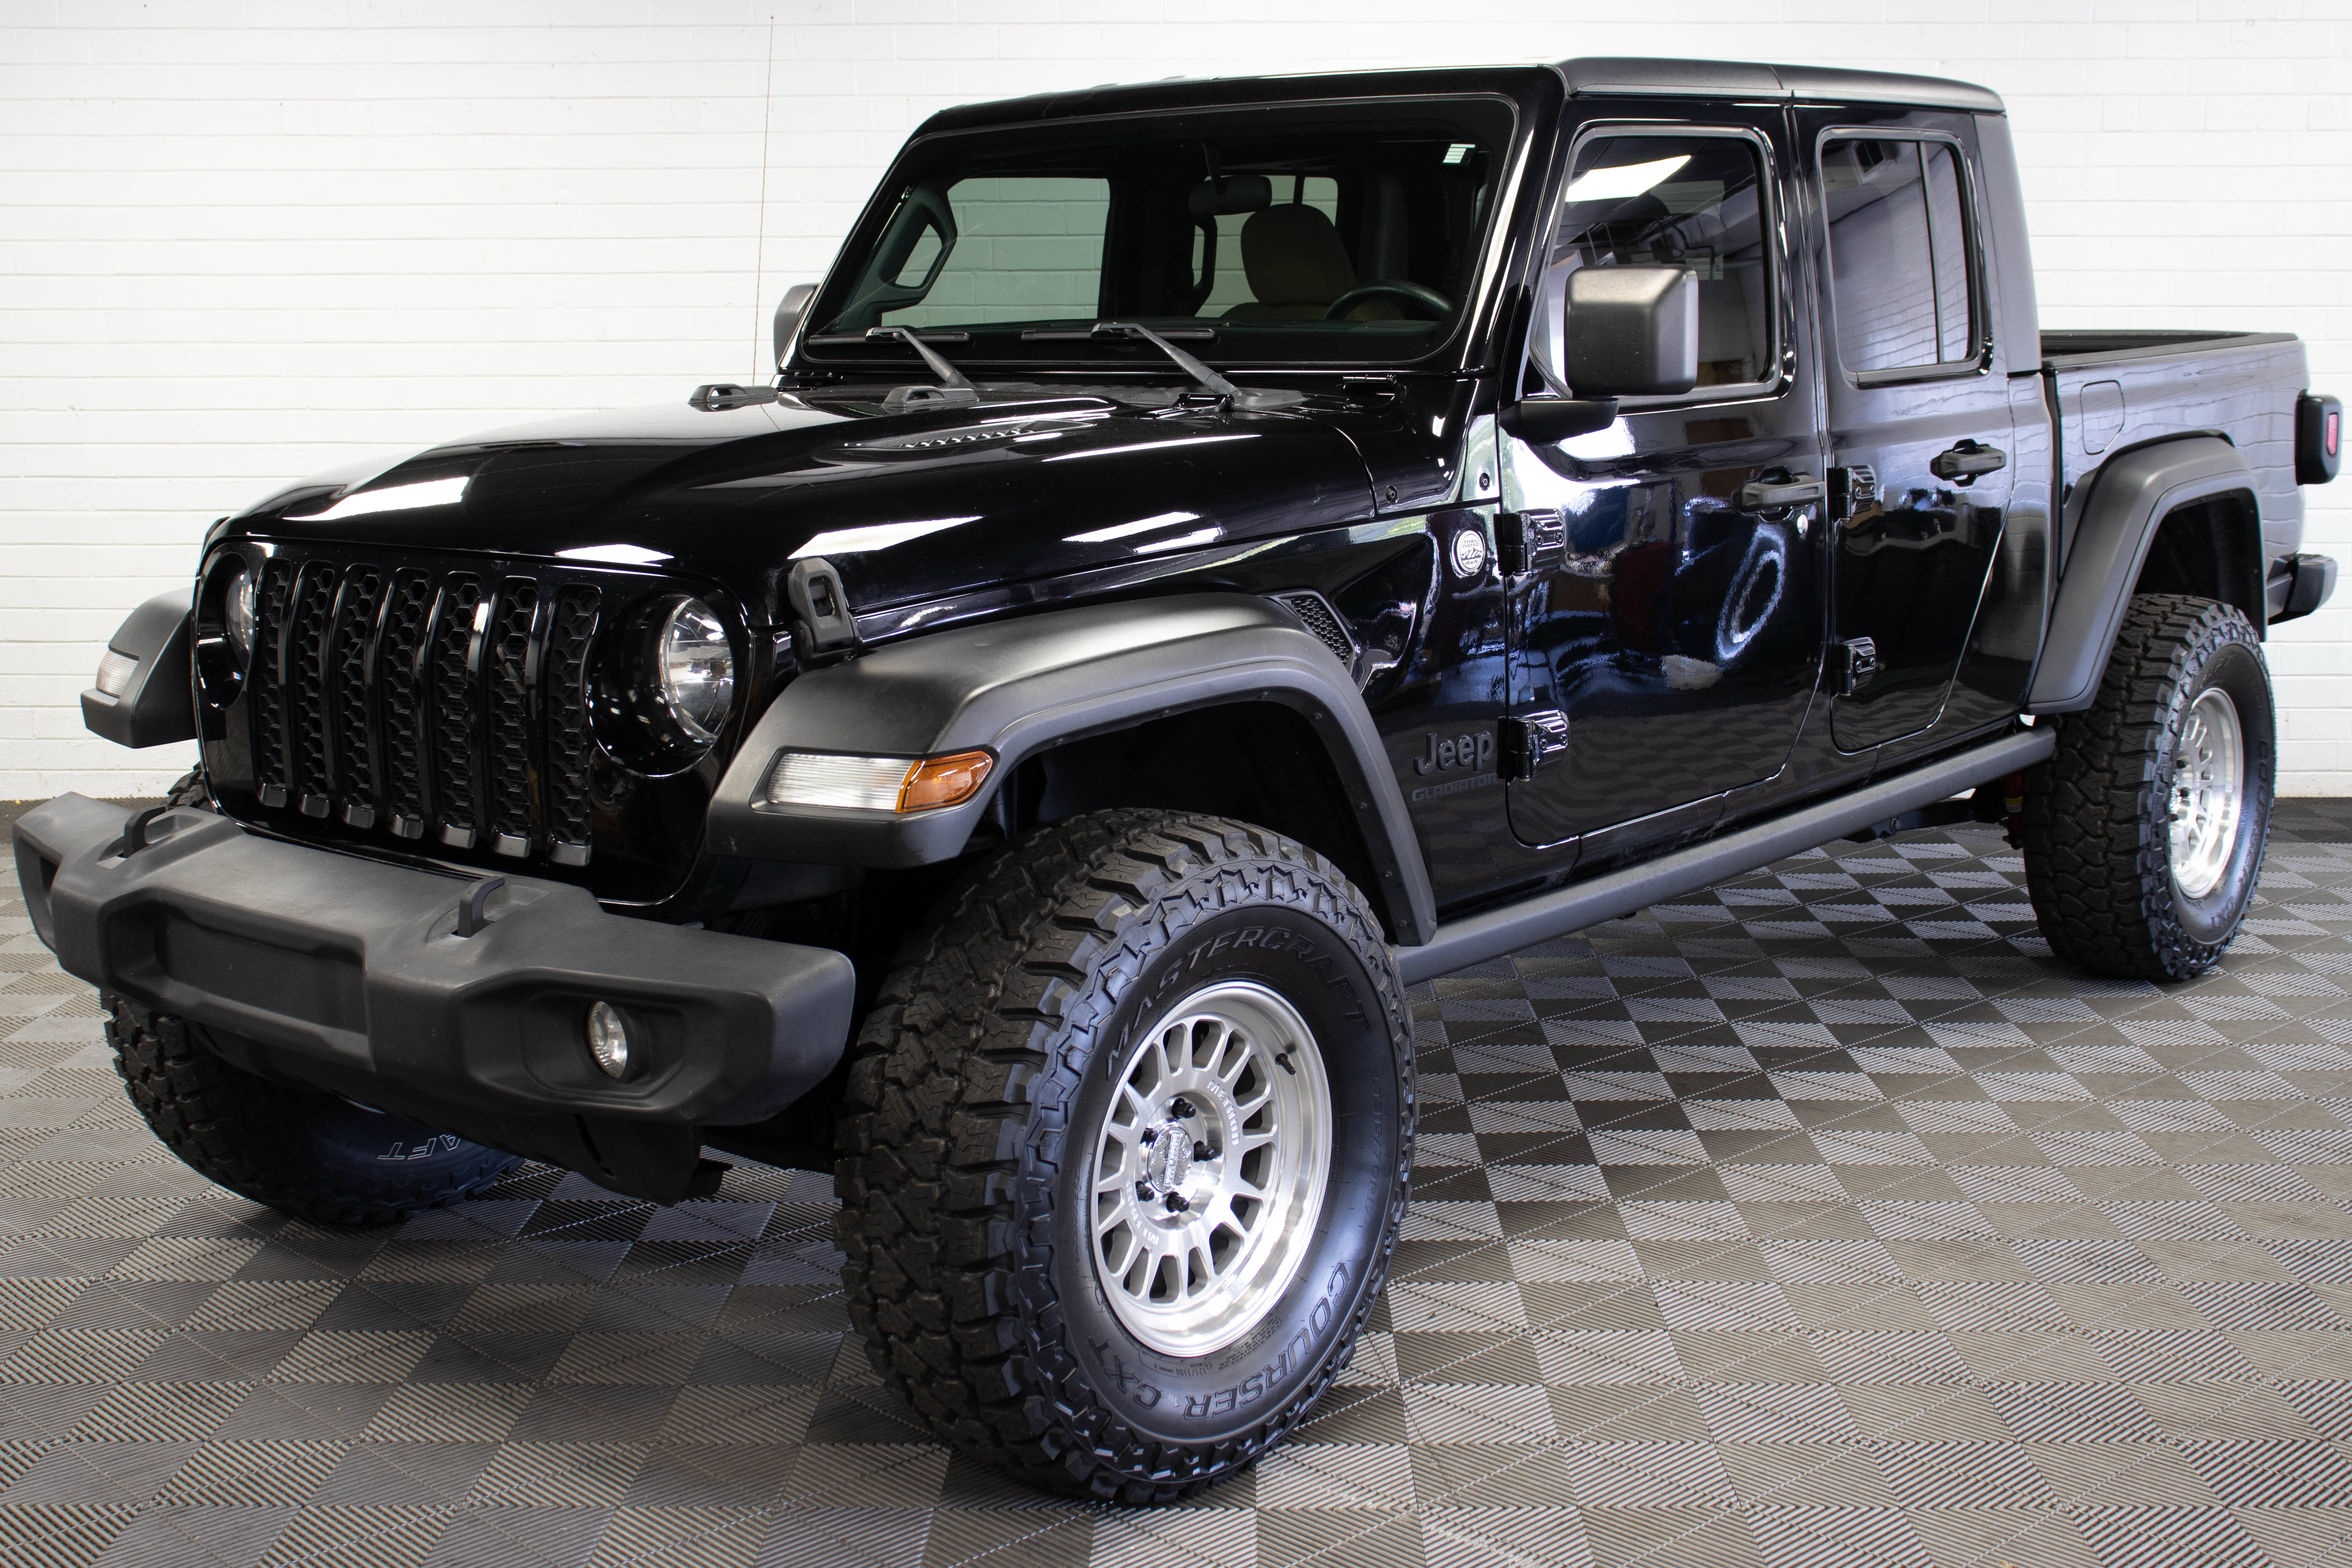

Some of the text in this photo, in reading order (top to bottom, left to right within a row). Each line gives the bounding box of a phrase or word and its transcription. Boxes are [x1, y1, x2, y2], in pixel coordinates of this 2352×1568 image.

[1412, 773, 1498, 802] GLADIATOR
[1413, 730, 1494, 776] Jeep
[1106, 926, 1372, 1081] MASTERCRAFT
[1207, 1079, 1240, 1146] METHOD
[1088, 1337, 1162, 1410] CXT
[1183, 1261, 1350, 1420] COURSER
